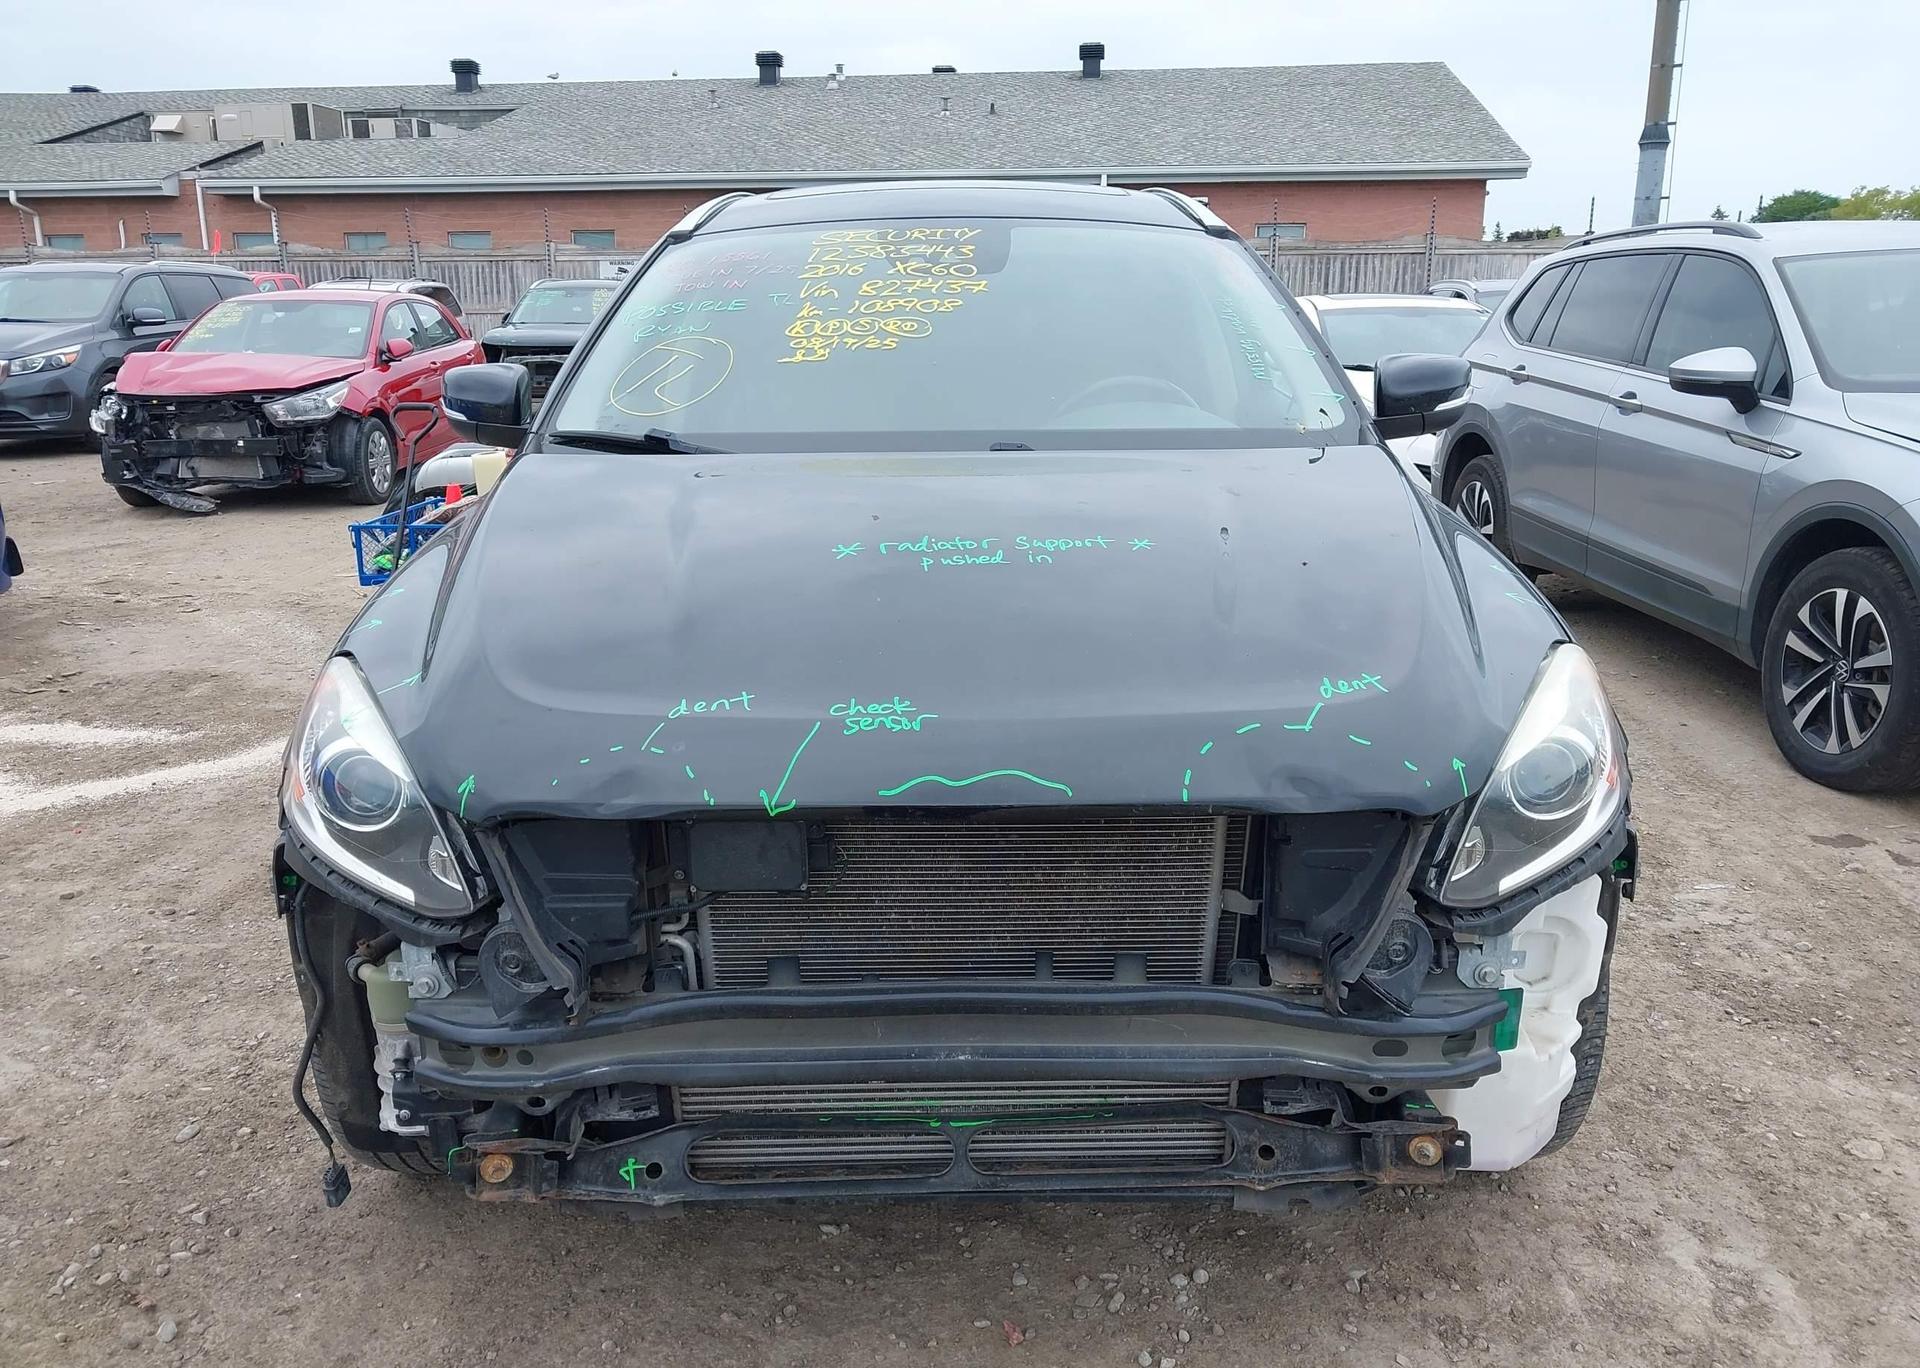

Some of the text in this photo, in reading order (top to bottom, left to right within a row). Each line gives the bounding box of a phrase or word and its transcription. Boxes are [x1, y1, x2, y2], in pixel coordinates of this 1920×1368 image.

[812, 228, 982, 245] SECURITY
[798, 261, 978, 279] 2016 XC60
[721, 279, 750, 289] IN
[858, 278, 990, 297] 827437
[624, 298, 749, 325] POSSIBLE
[633, 322, 711, 342] RYAN
[879, 535, 1000, 554] radiator
[920, 549, 1053, 571] pushed in
[1320, 672, 1389, 698] dent
[667, 691, 756, 719] dent
[829, 696, 917, 716] check
[843, 713, 939, 735] sensor
